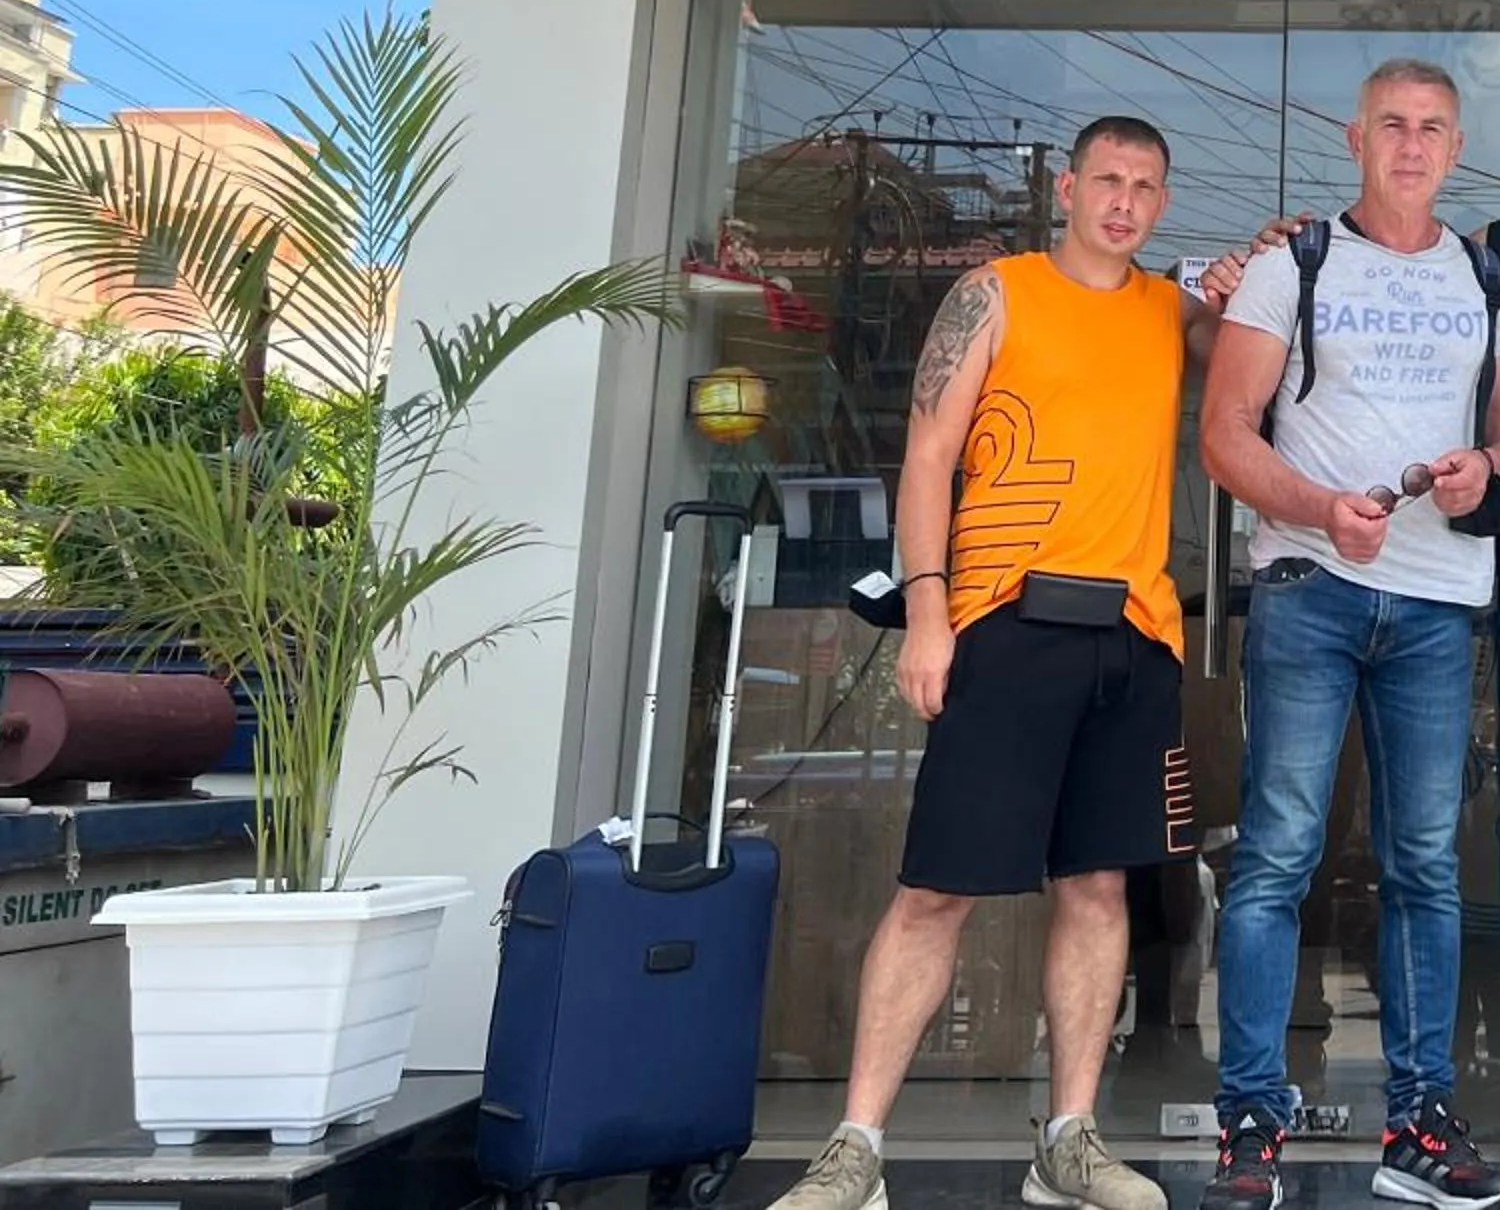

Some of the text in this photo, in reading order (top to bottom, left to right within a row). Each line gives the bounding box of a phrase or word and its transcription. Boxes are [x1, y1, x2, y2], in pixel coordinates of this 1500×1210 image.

[1403, 266, 1447, 283] NOW
[1314, 301, 1486, 339] BAREFOOT
[1375, 342, 1435, 361] WILD
[1351, 364, 1451, 384] AND FREE
[2, 889, 85, 926] SILENT
